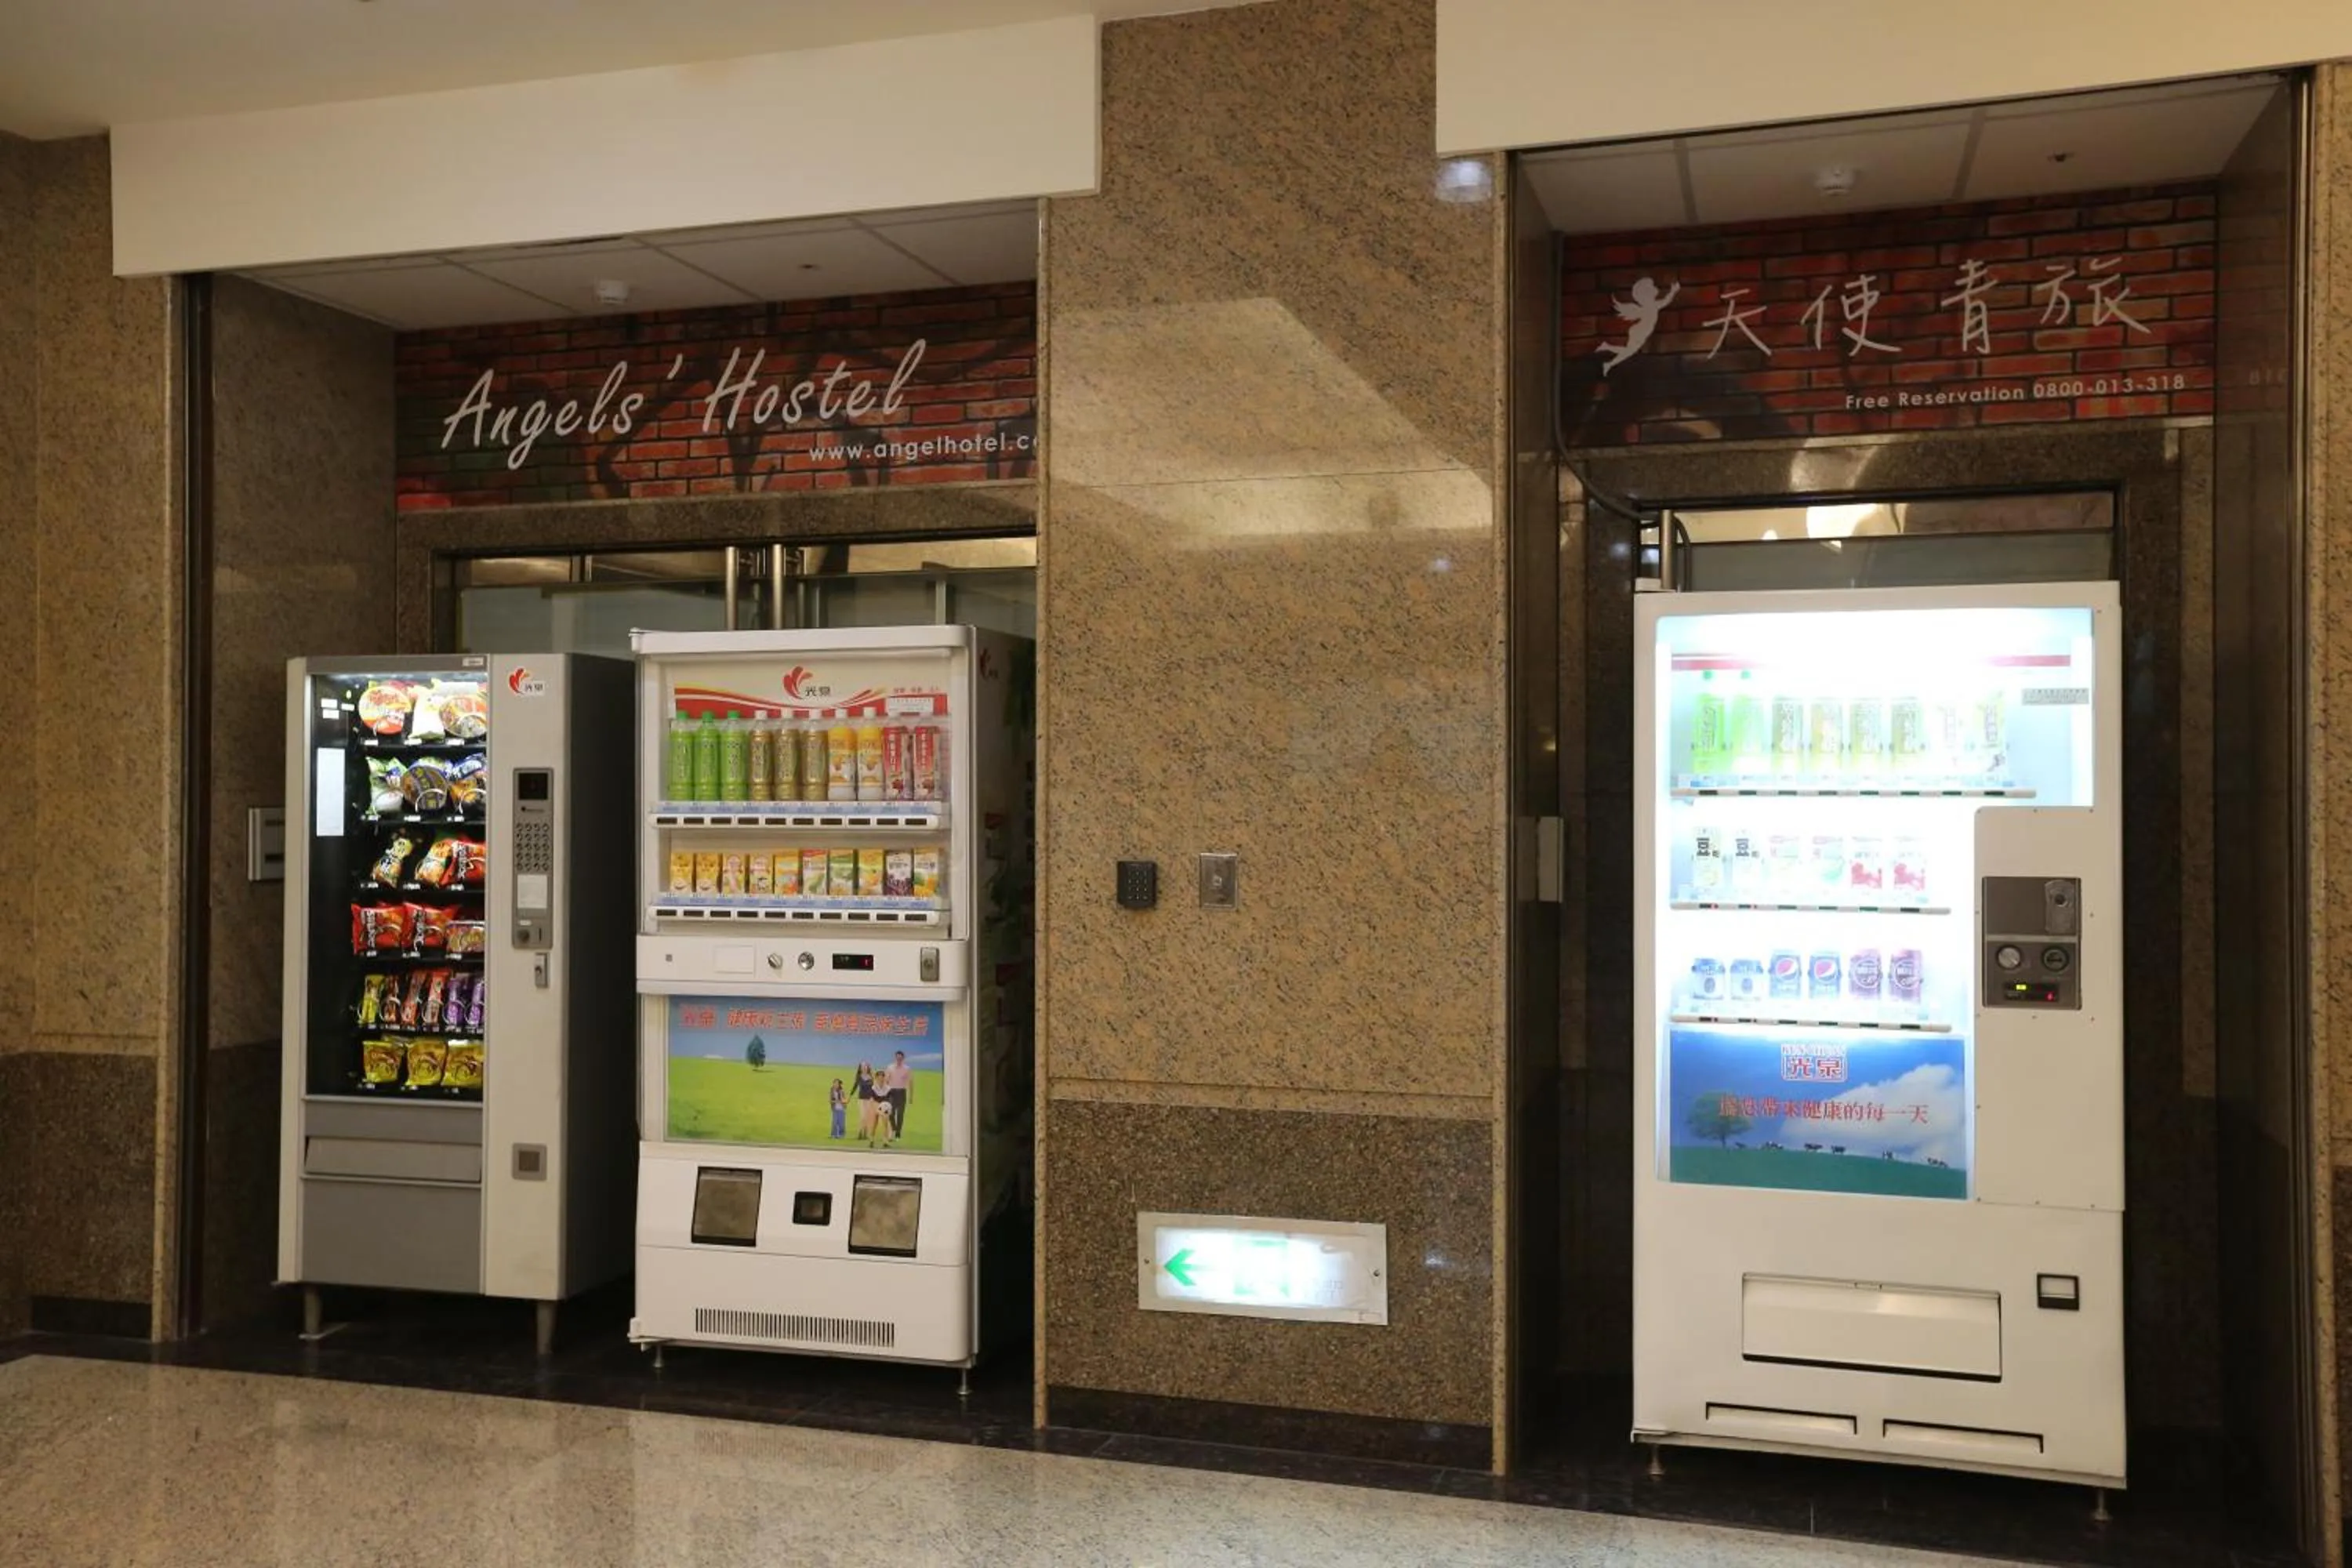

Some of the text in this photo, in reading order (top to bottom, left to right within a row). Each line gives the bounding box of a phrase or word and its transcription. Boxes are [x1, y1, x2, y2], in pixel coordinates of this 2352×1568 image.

[1702, 256, 2151, 360] 天使青旅
[702, 338, 927, 433] Hostel
[1845, 375, 2186, 410] Free Reservation 0800-013-318
